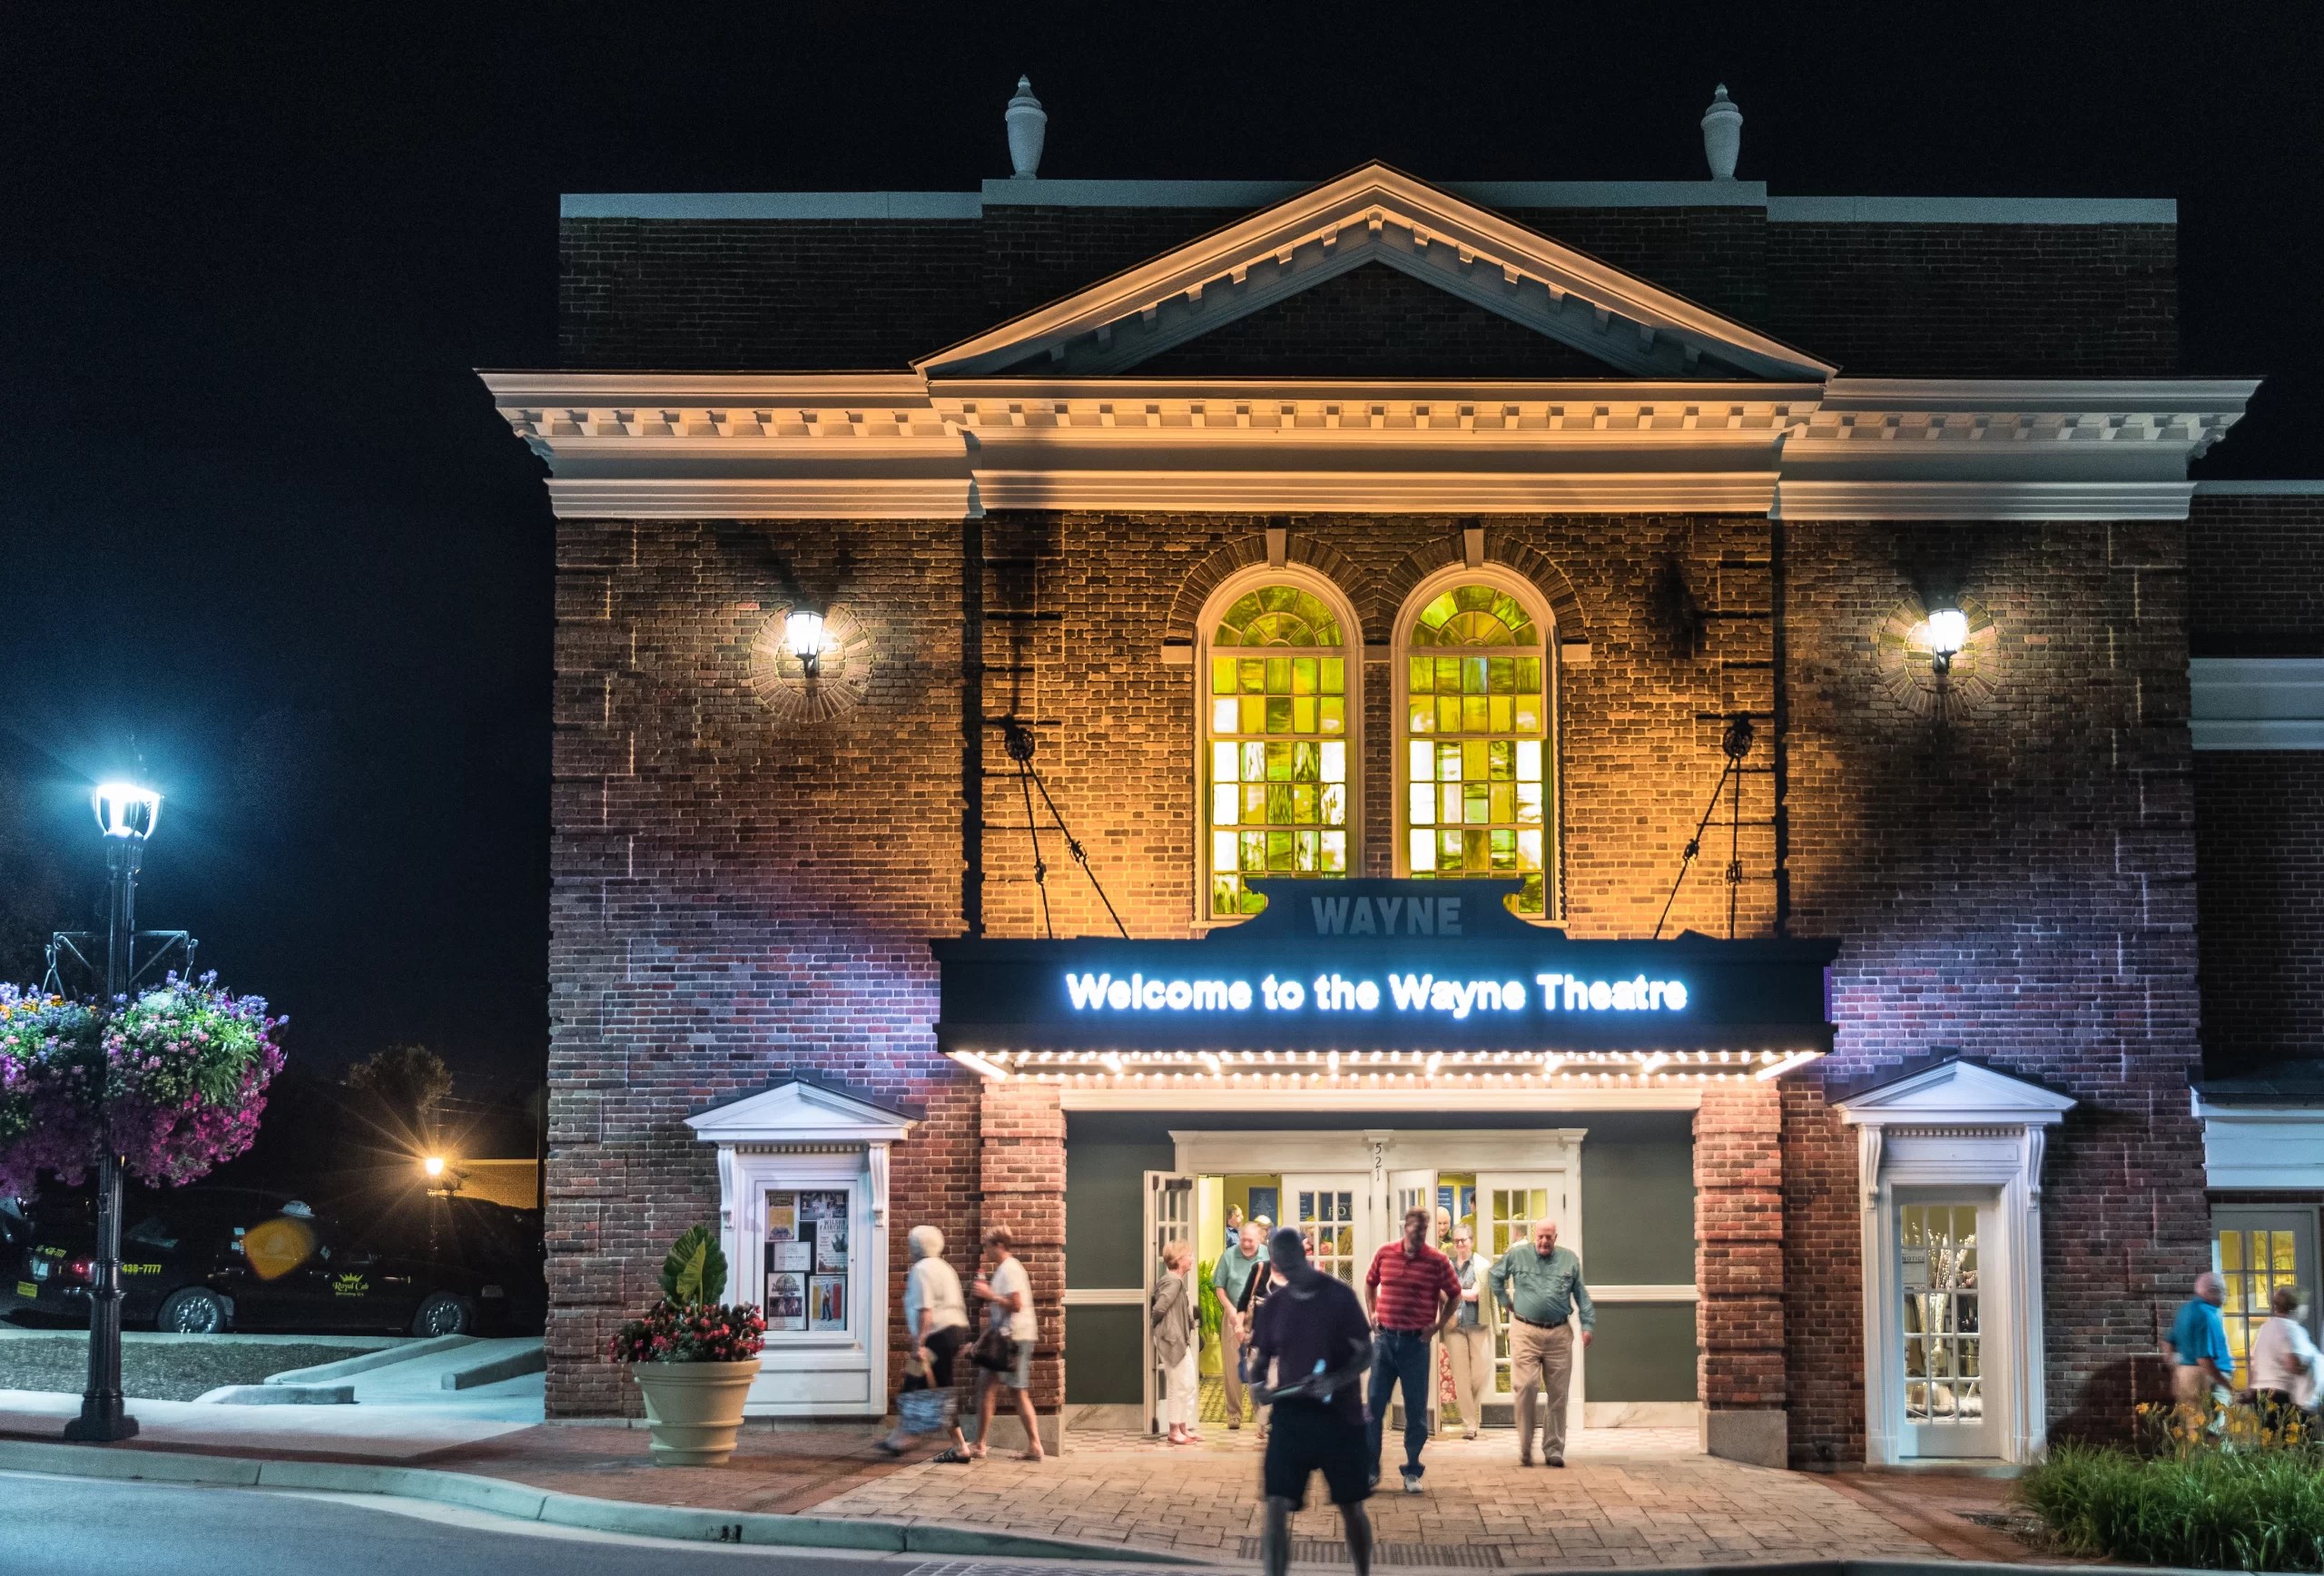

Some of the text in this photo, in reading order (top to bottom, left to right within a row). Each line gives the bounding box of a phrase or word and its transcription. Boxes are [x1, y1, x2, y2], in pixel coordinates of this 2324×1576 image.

[1311, 896, 1462, 935] WAYNE
[1066, 972, 1688, 1019] Welcome to the Wayne Theatre
[1374, 1142, 1383, 1181] 521
[332, 1282, 369, 1292] Royal Cab
